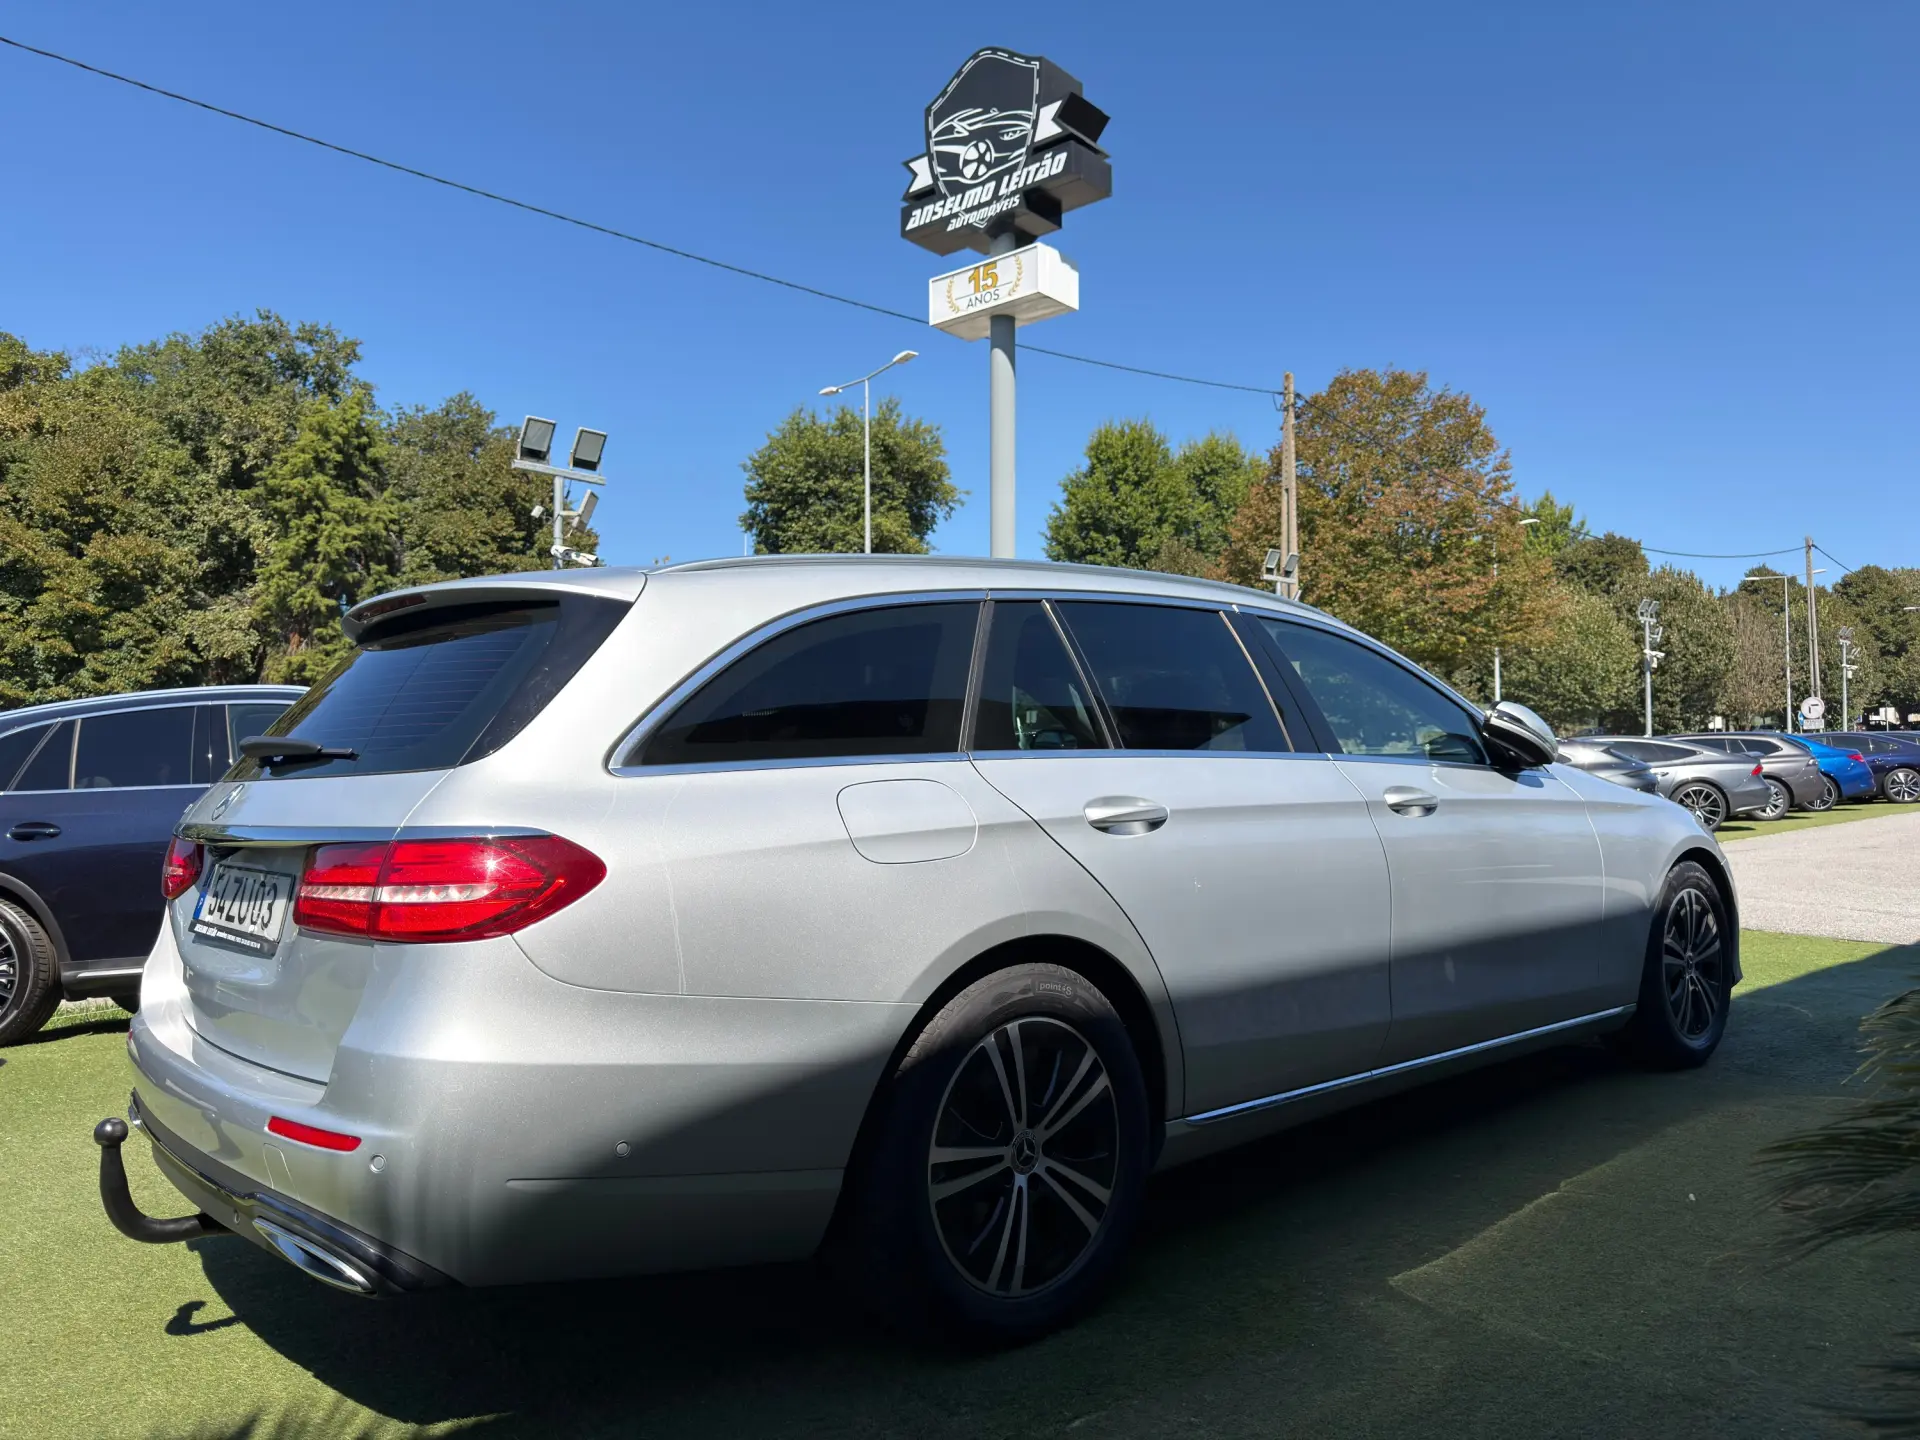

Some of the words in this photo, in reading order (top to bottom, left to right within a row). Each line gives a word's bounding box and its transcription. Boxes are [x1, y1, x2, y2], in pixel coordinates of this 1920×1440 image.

[998, 151, 1068, 197] LEITÃO
[968, 260, 999, 294] 15
[966, 288, 1000, 309] ANOS
